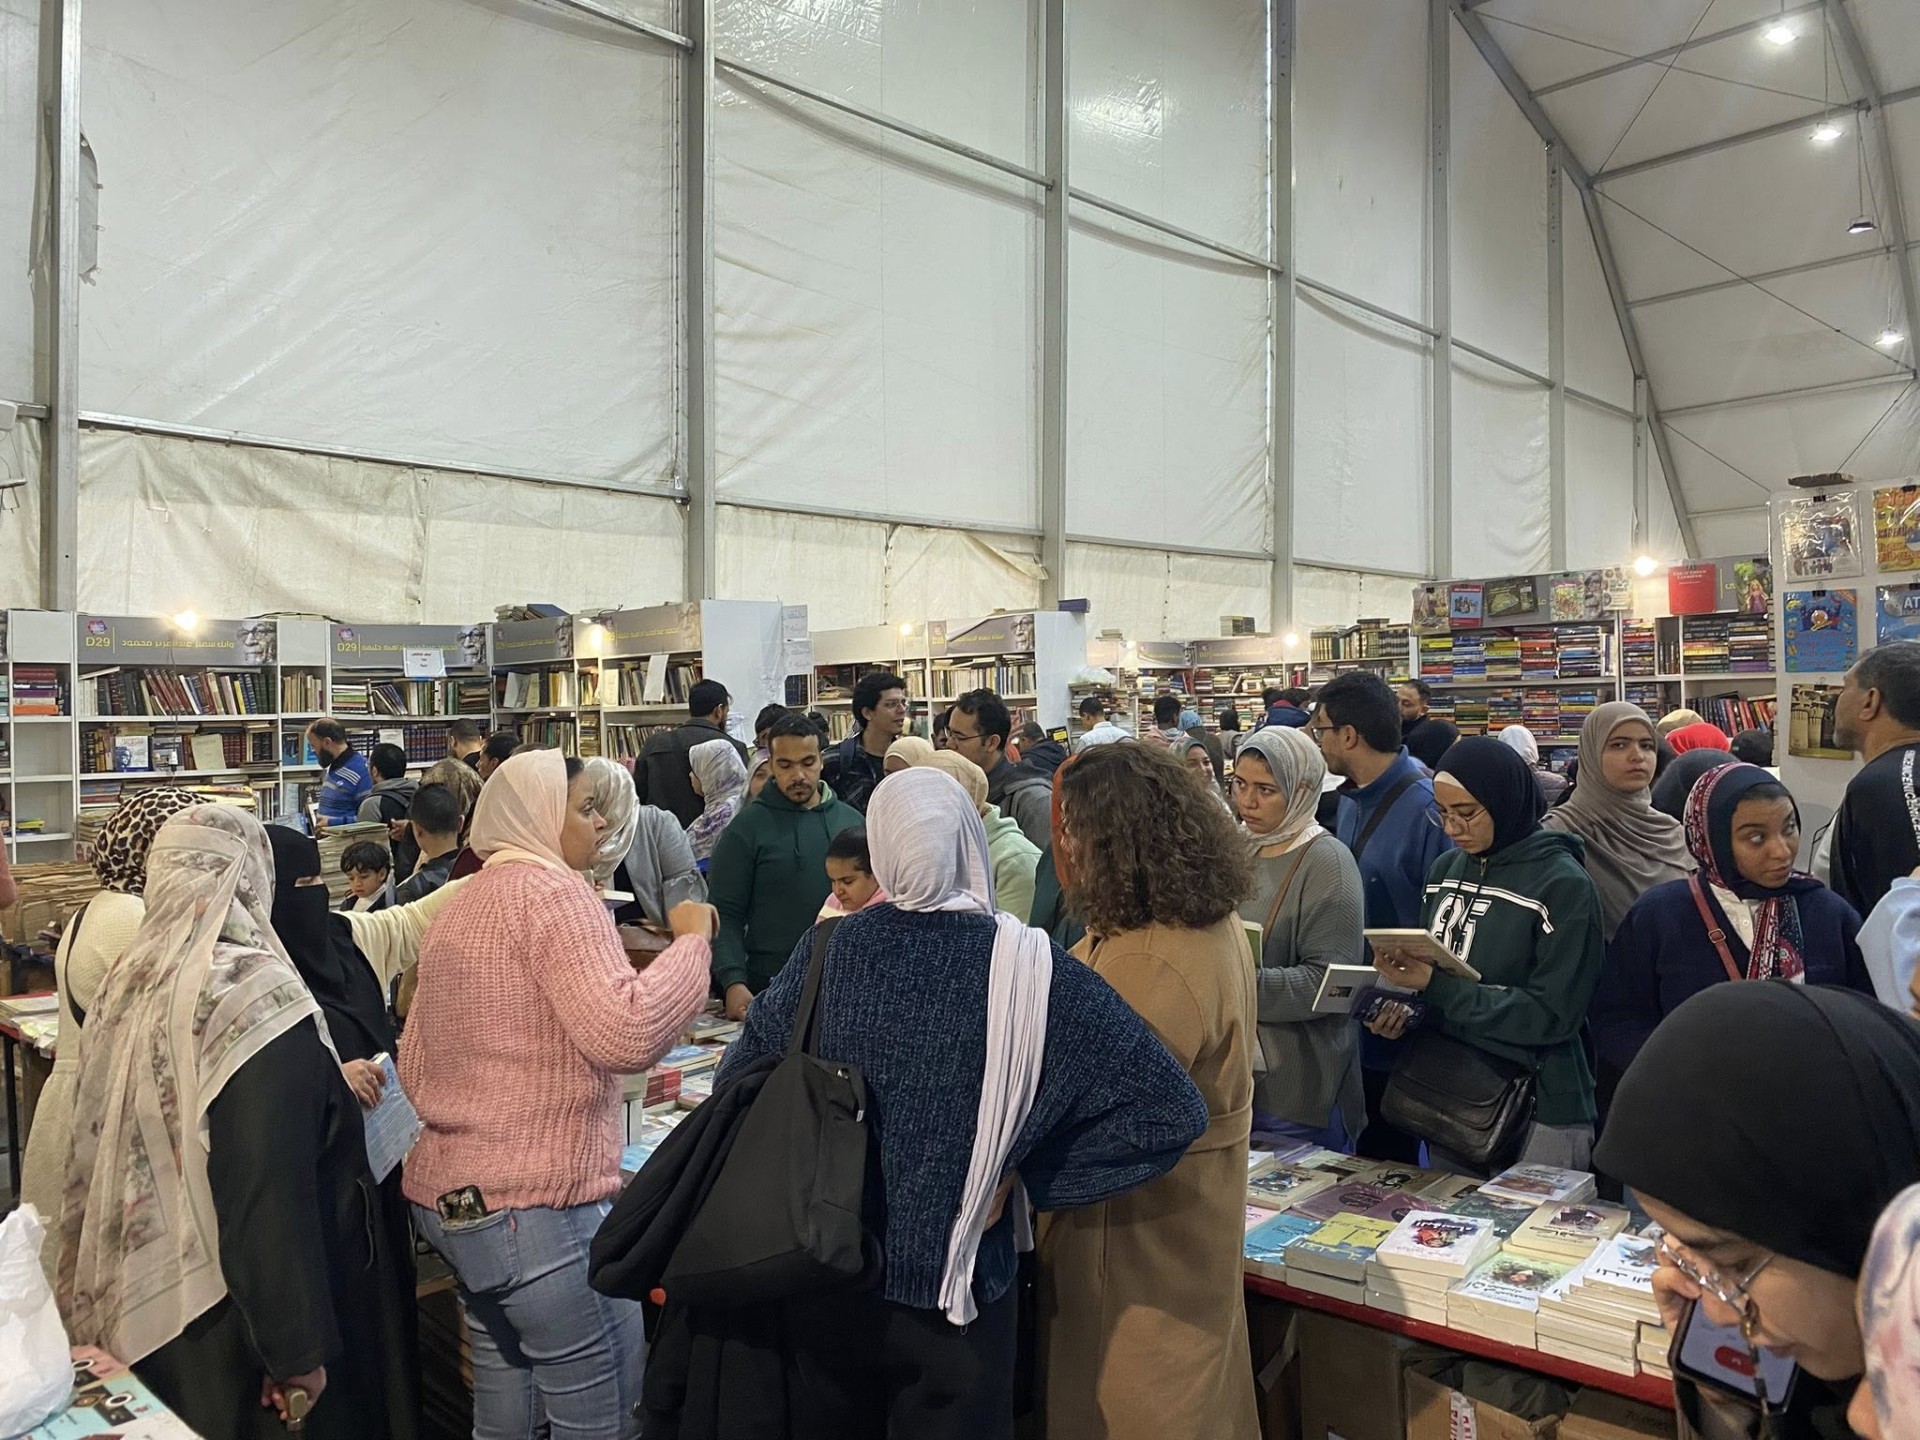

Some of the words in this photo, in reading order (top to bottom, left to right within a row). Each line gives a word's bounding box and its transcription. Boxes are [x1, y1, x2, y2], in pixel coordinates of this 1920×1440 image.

[85, 637, 111, 647] D29
[121, 638, 153, 648] محمود
[336, 643, 357, 652] D29
[1430, 892, 1492, 963] 85
